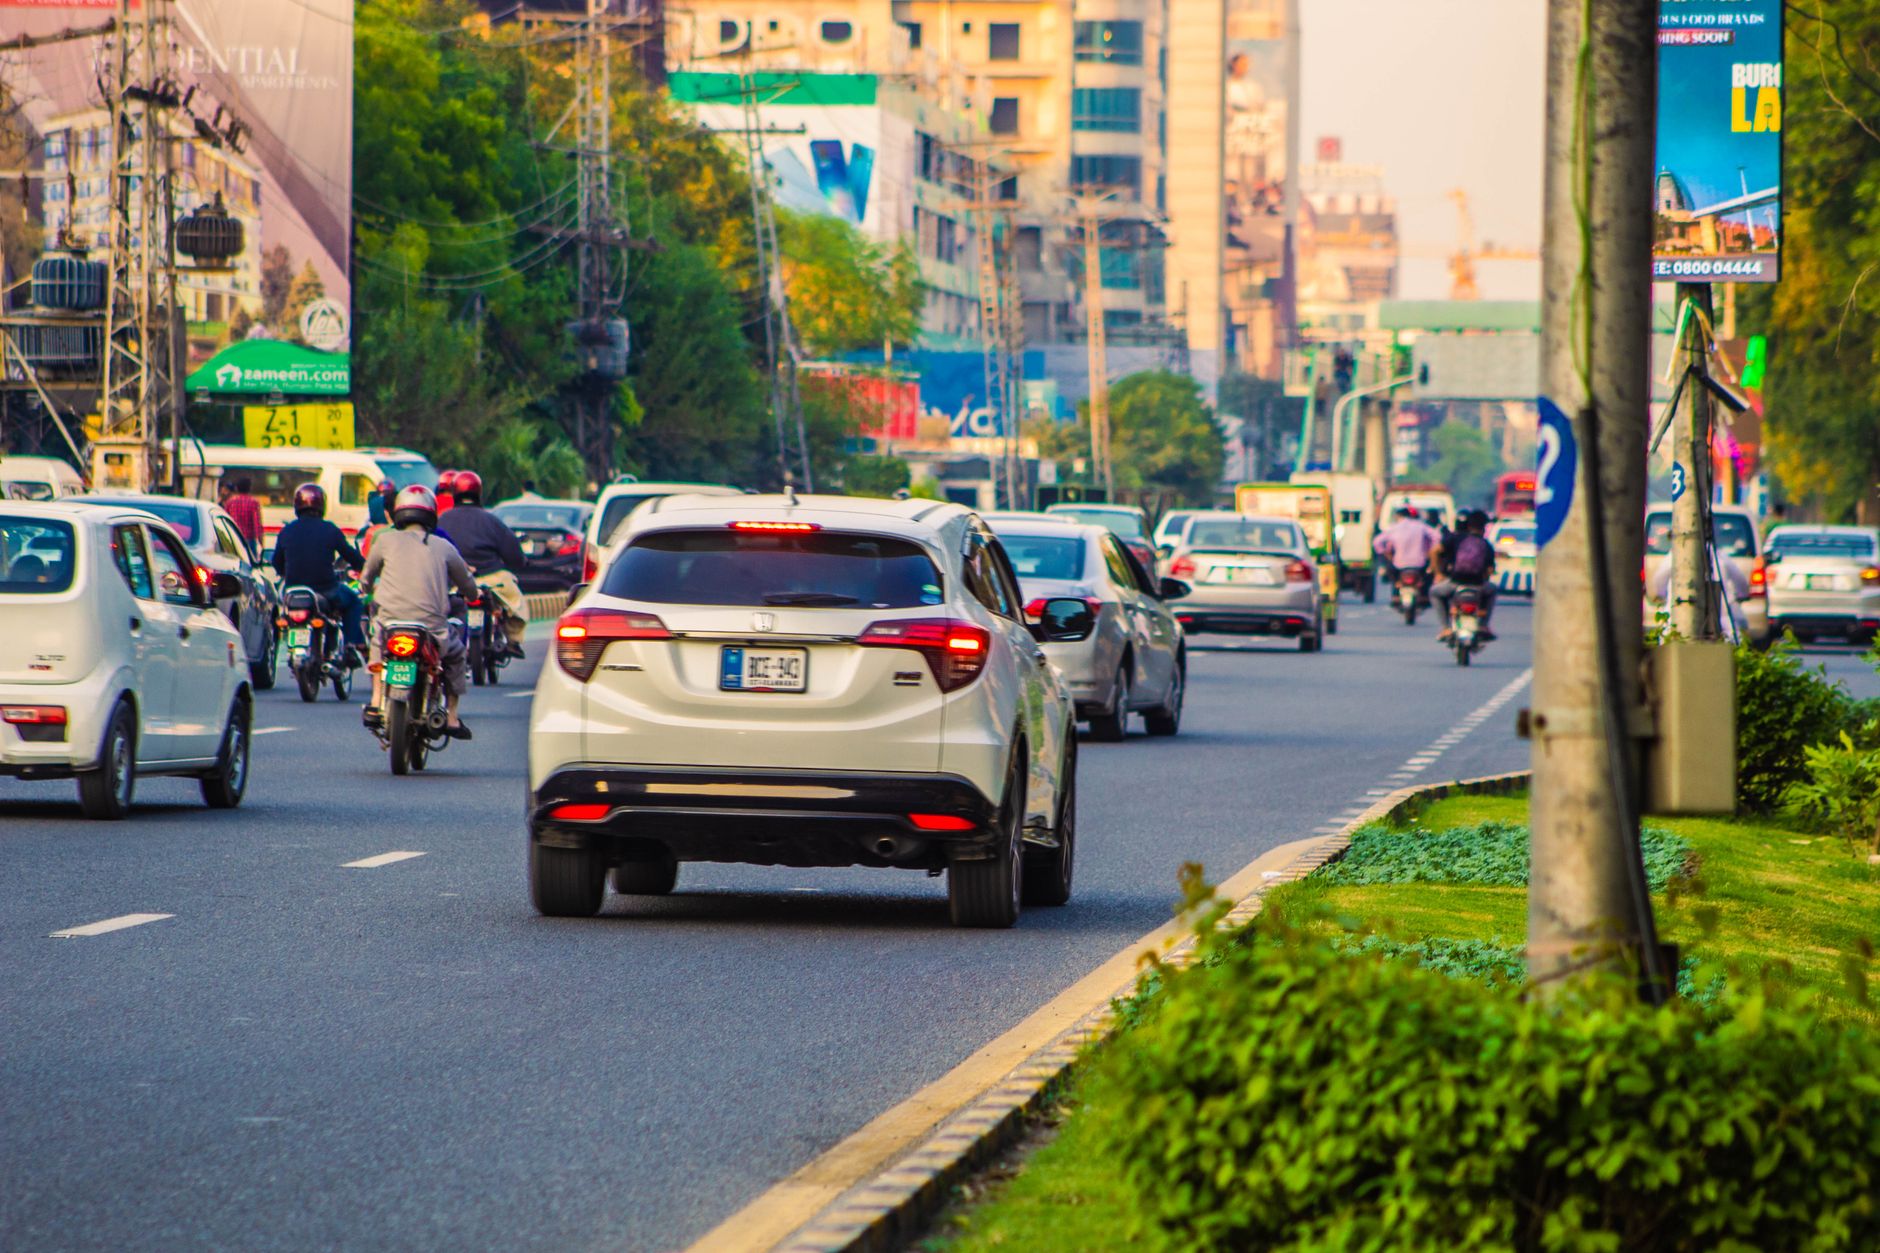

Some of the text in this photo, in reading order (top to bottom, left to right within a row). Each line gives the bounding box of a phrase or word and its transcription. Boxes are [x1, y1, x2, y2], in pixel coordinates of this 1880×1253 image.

[1682, 14, 1716, 25] FOOD
[1717, 14, 1764, 25] BRANDS
[1691, 31, 1731, 43] SOON
[1673, 260, 1710, 275] 0800
[1712, 260, 1761, 275] 04444
[244, 368, 349, 382] zameen.com
[265, 408, 298, 433] Z-1
